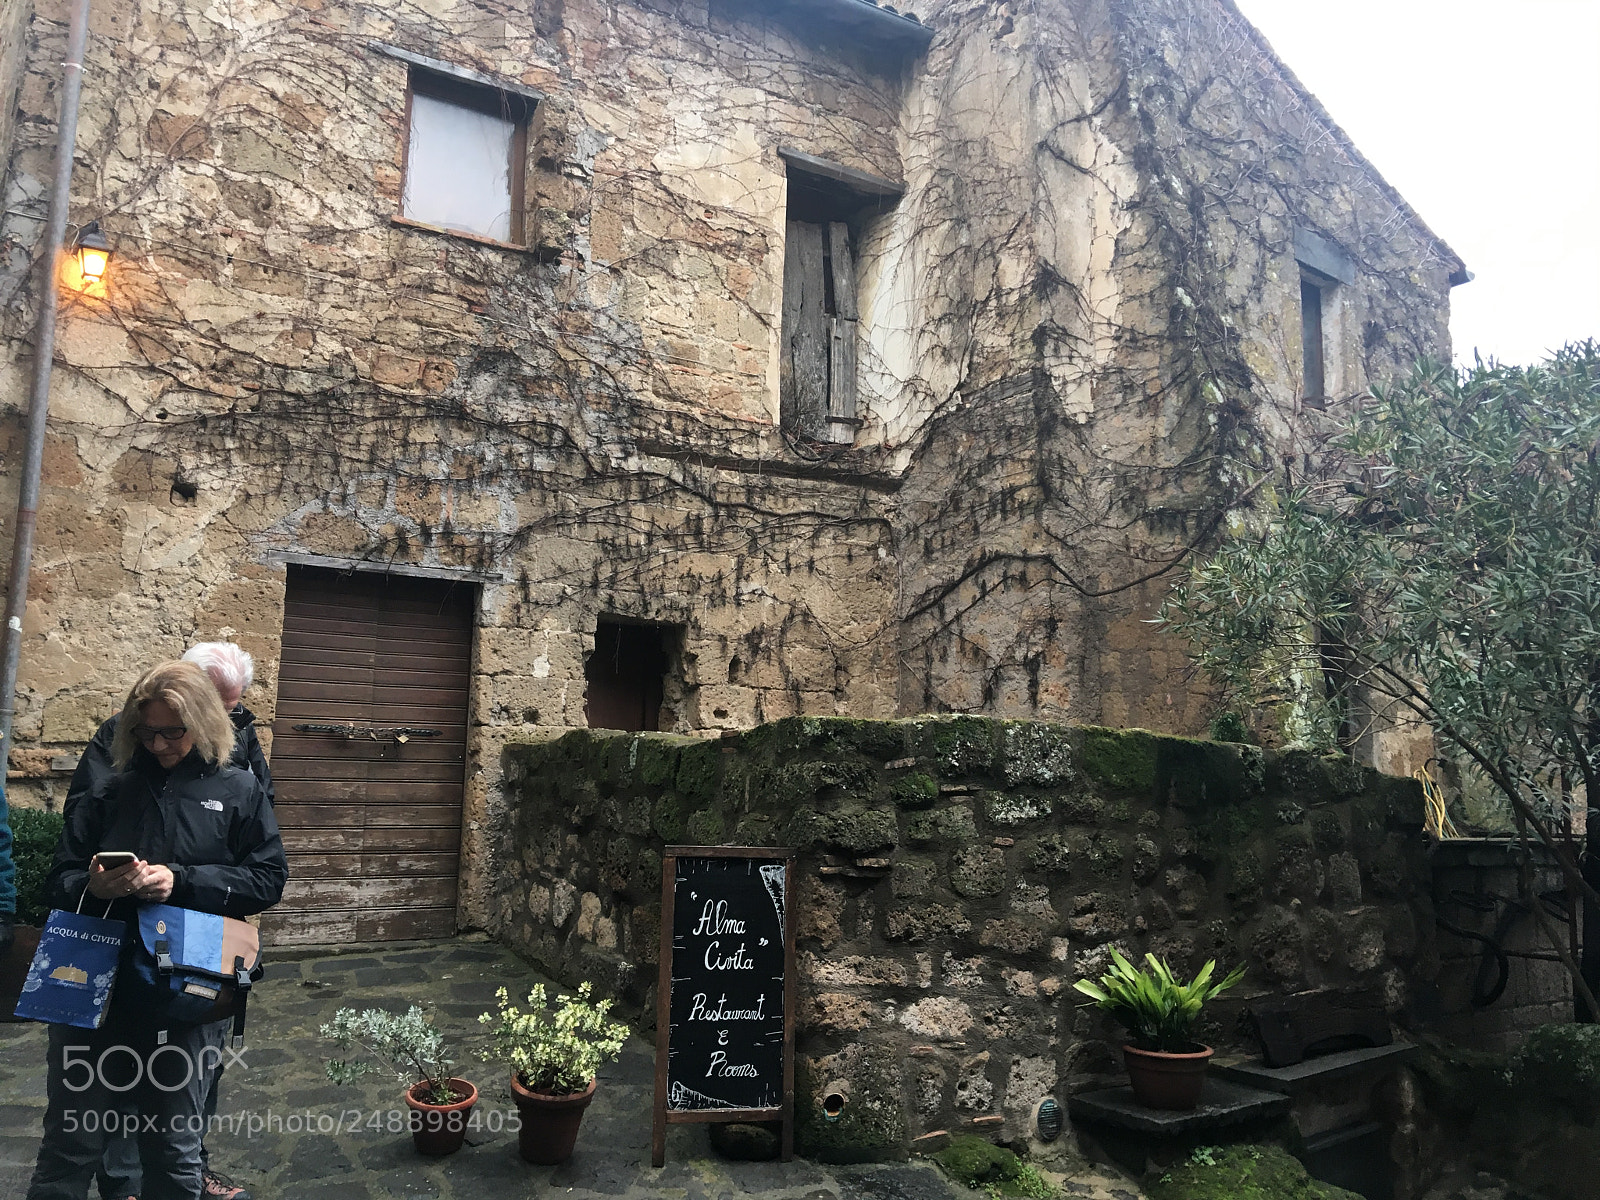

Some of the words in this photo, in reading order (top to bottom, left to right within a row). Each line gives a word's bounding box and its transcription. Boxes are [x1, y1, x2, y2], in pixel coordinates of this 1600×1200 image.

[47, 926, 78, 937] ACQUA
[80, 932, 89, 940] di
[91, 934, 121, 946] CIVITA
[688, 993, 765, 1021] Restaurant
[705, 1051, 760, 1077] Rooms
